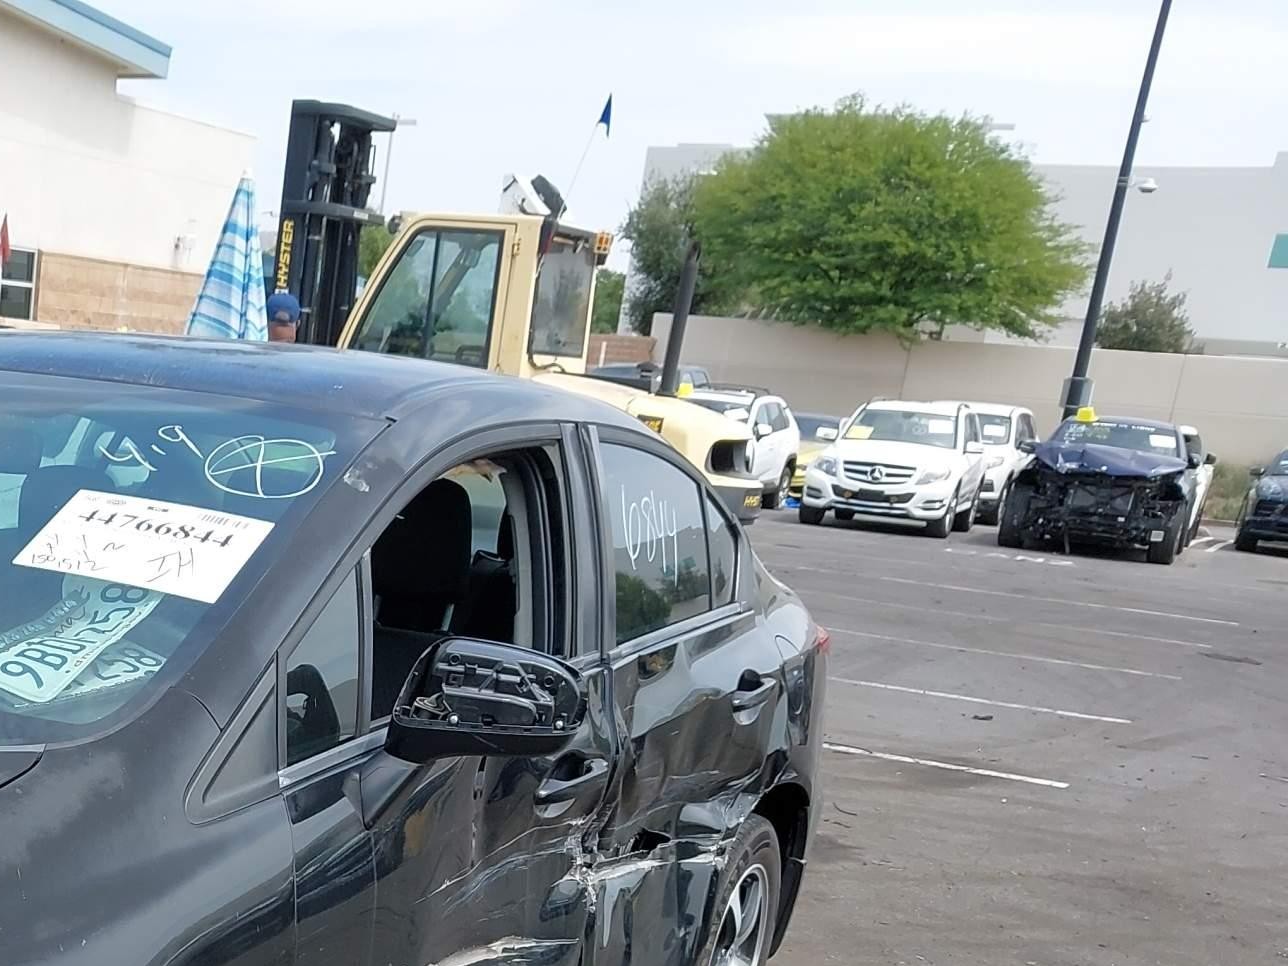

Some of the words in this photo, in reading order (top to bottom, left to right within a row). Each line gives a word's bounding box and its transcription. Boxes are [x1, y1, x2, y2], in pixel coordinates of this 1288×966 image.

[276, 219, 294, 288] HYSTER
[78, 509, 235, 548] 44766844
[620, 484, 679, 588] 6844
